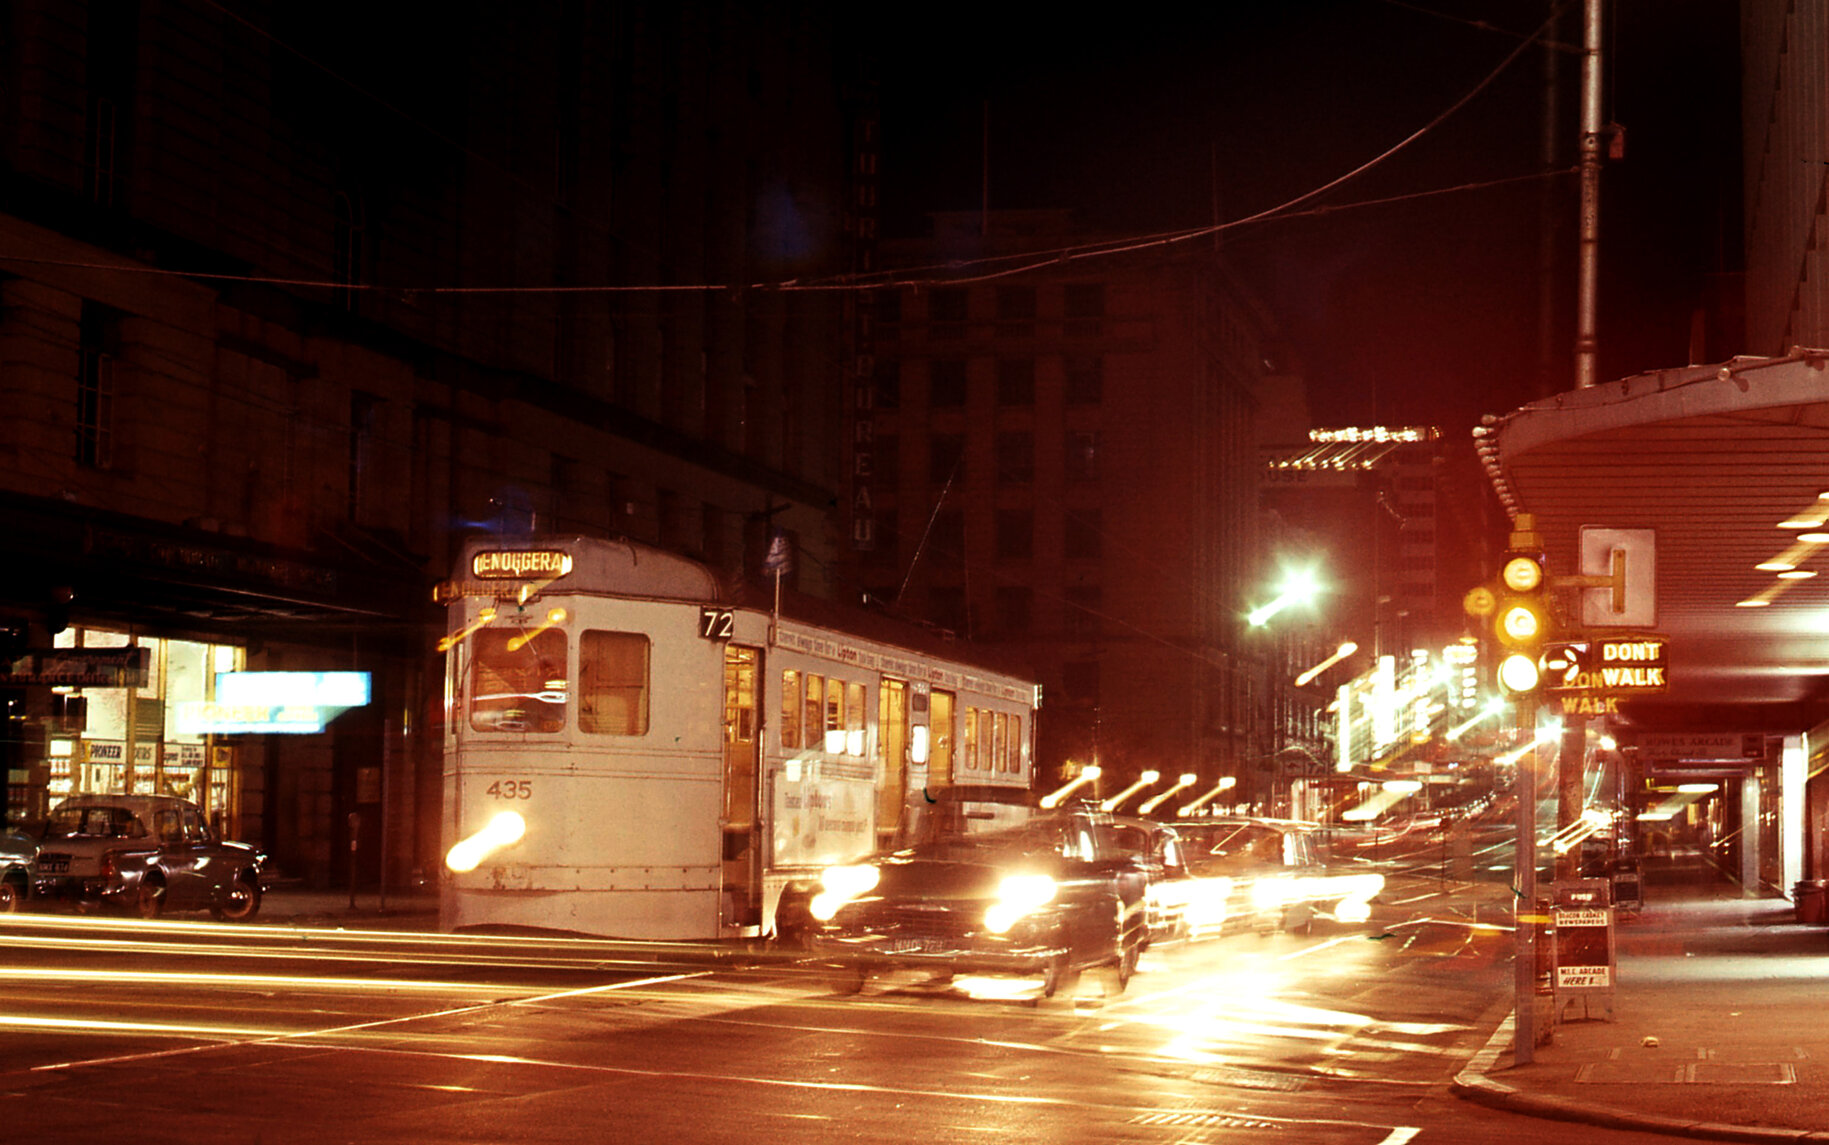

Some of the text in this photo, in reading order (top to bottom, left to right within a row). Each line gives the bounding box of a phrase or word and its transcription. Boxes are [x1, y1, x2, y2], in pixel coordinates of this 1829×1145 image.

[854, 353, 874, 542] BUREAU
[481, 552, 562, 571] ENOGGERA
[703, 611, 733, 638] 72
[1602, 668, 1664, 686] WALK
[90, 744, 122, 759] PIONEER
[486, 780, 532, 800] 435
[1579, 967, 1606, 975] ARCADE
